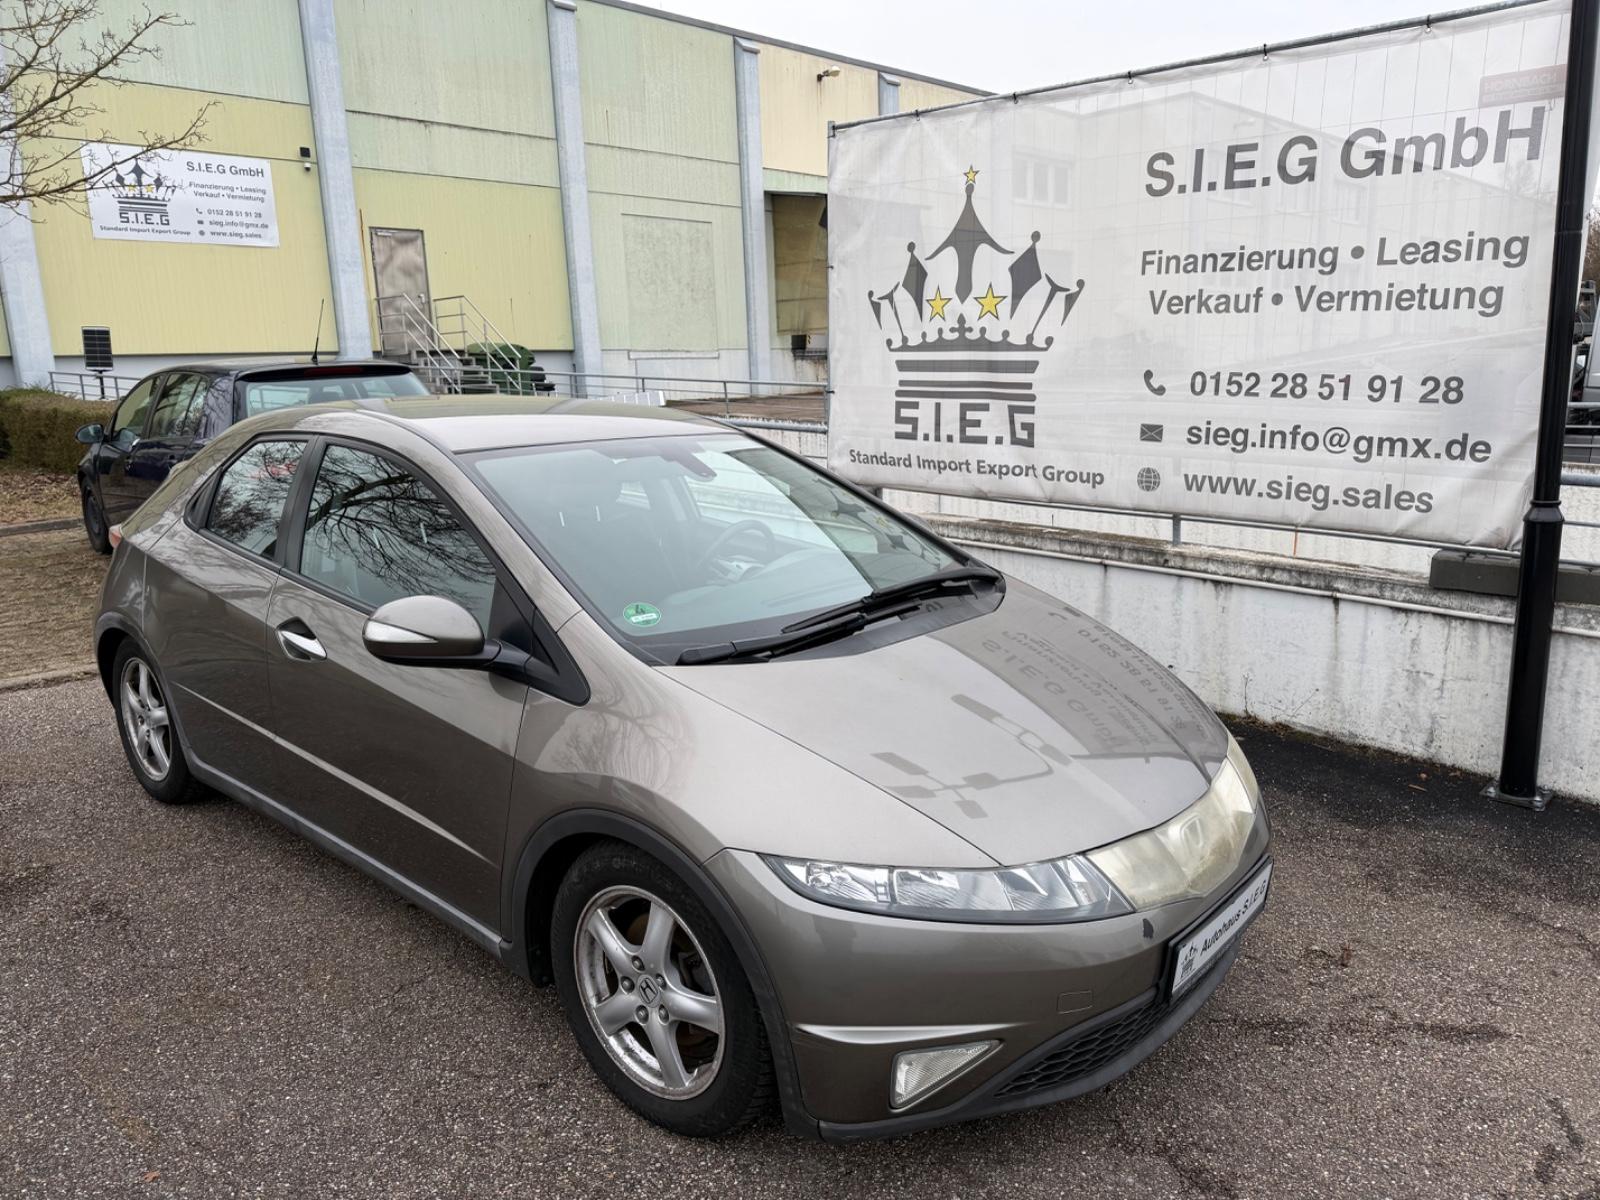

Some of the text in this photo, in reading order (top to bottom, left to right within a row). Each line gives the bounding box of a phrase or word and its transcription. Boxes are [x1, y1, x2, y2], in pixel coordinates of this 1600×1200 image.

[186, 161, 264, 178] S.I.E.G GmbH
[1146, 106, 1546, 197] S.I.E.G GmbH
[189, 181, 266, 195] Finanzierung Leasing
[194, 190, 265, 204] Verkauf Vermietung
[120, 212, 170, 226] S.I.E.G
[207, 208, 224, 216] 0152
[1141, 231, 1530, 275] Finanzierung Leasing
[1149, 283, 1504, 318] Verkauf Vermietung
[1190, 370, 1464, 404] 0152 28 51 91 28
[894, 400, 1036, 448] S.I.E.G
[1186, 420, 1492, 463] sieg.info@gmx.de
[849, 448, 1105, 489] Standard Import Export Group
[1183, 472, 1434, 513] www.sieg.sales
[1200, 909, 1241, 957] Autohaus
